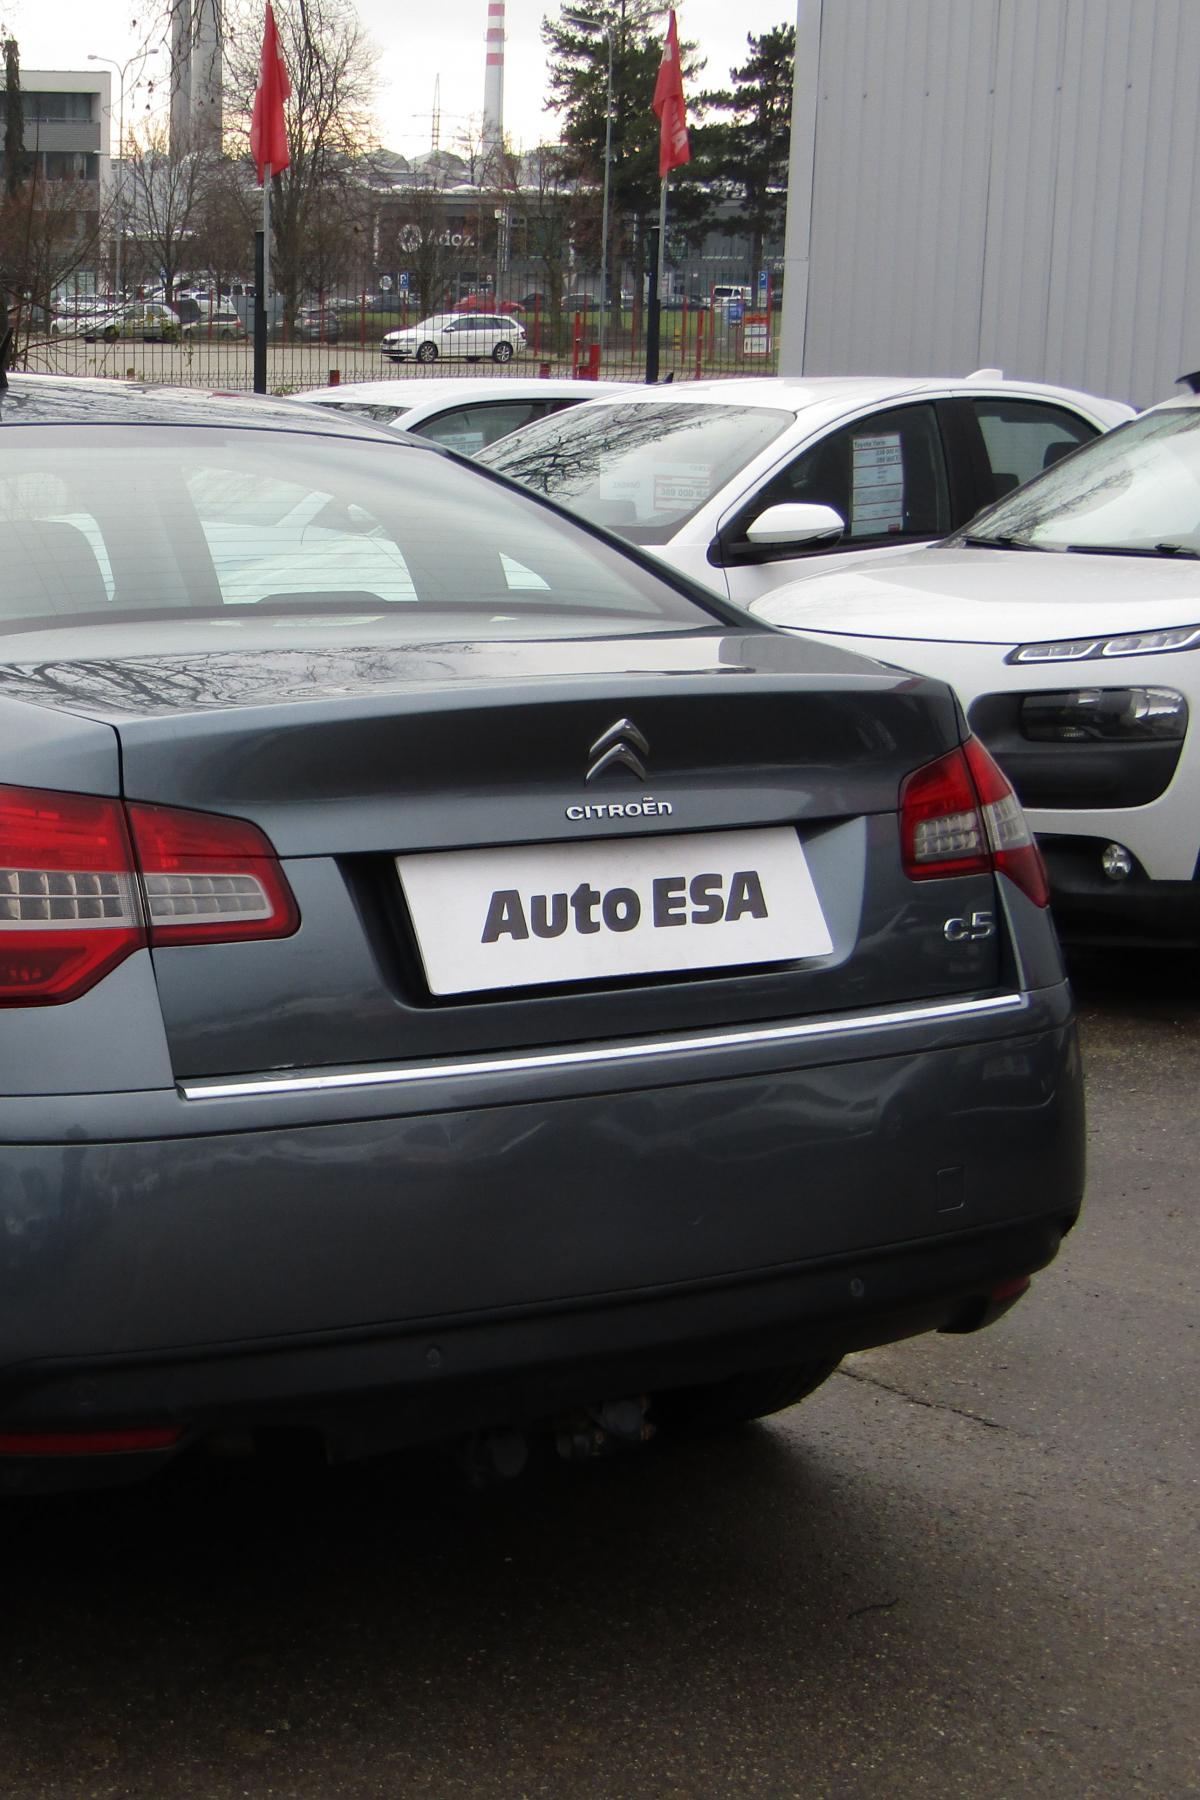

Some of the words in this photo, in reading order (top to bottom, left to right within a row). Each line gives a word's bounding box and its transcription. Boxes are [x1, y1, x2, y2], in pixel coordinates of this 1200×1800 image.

[481, 883, 641, 943] Auto
[653, 871, 768, 928] ESA
[944, 911, 993, 941] C5
